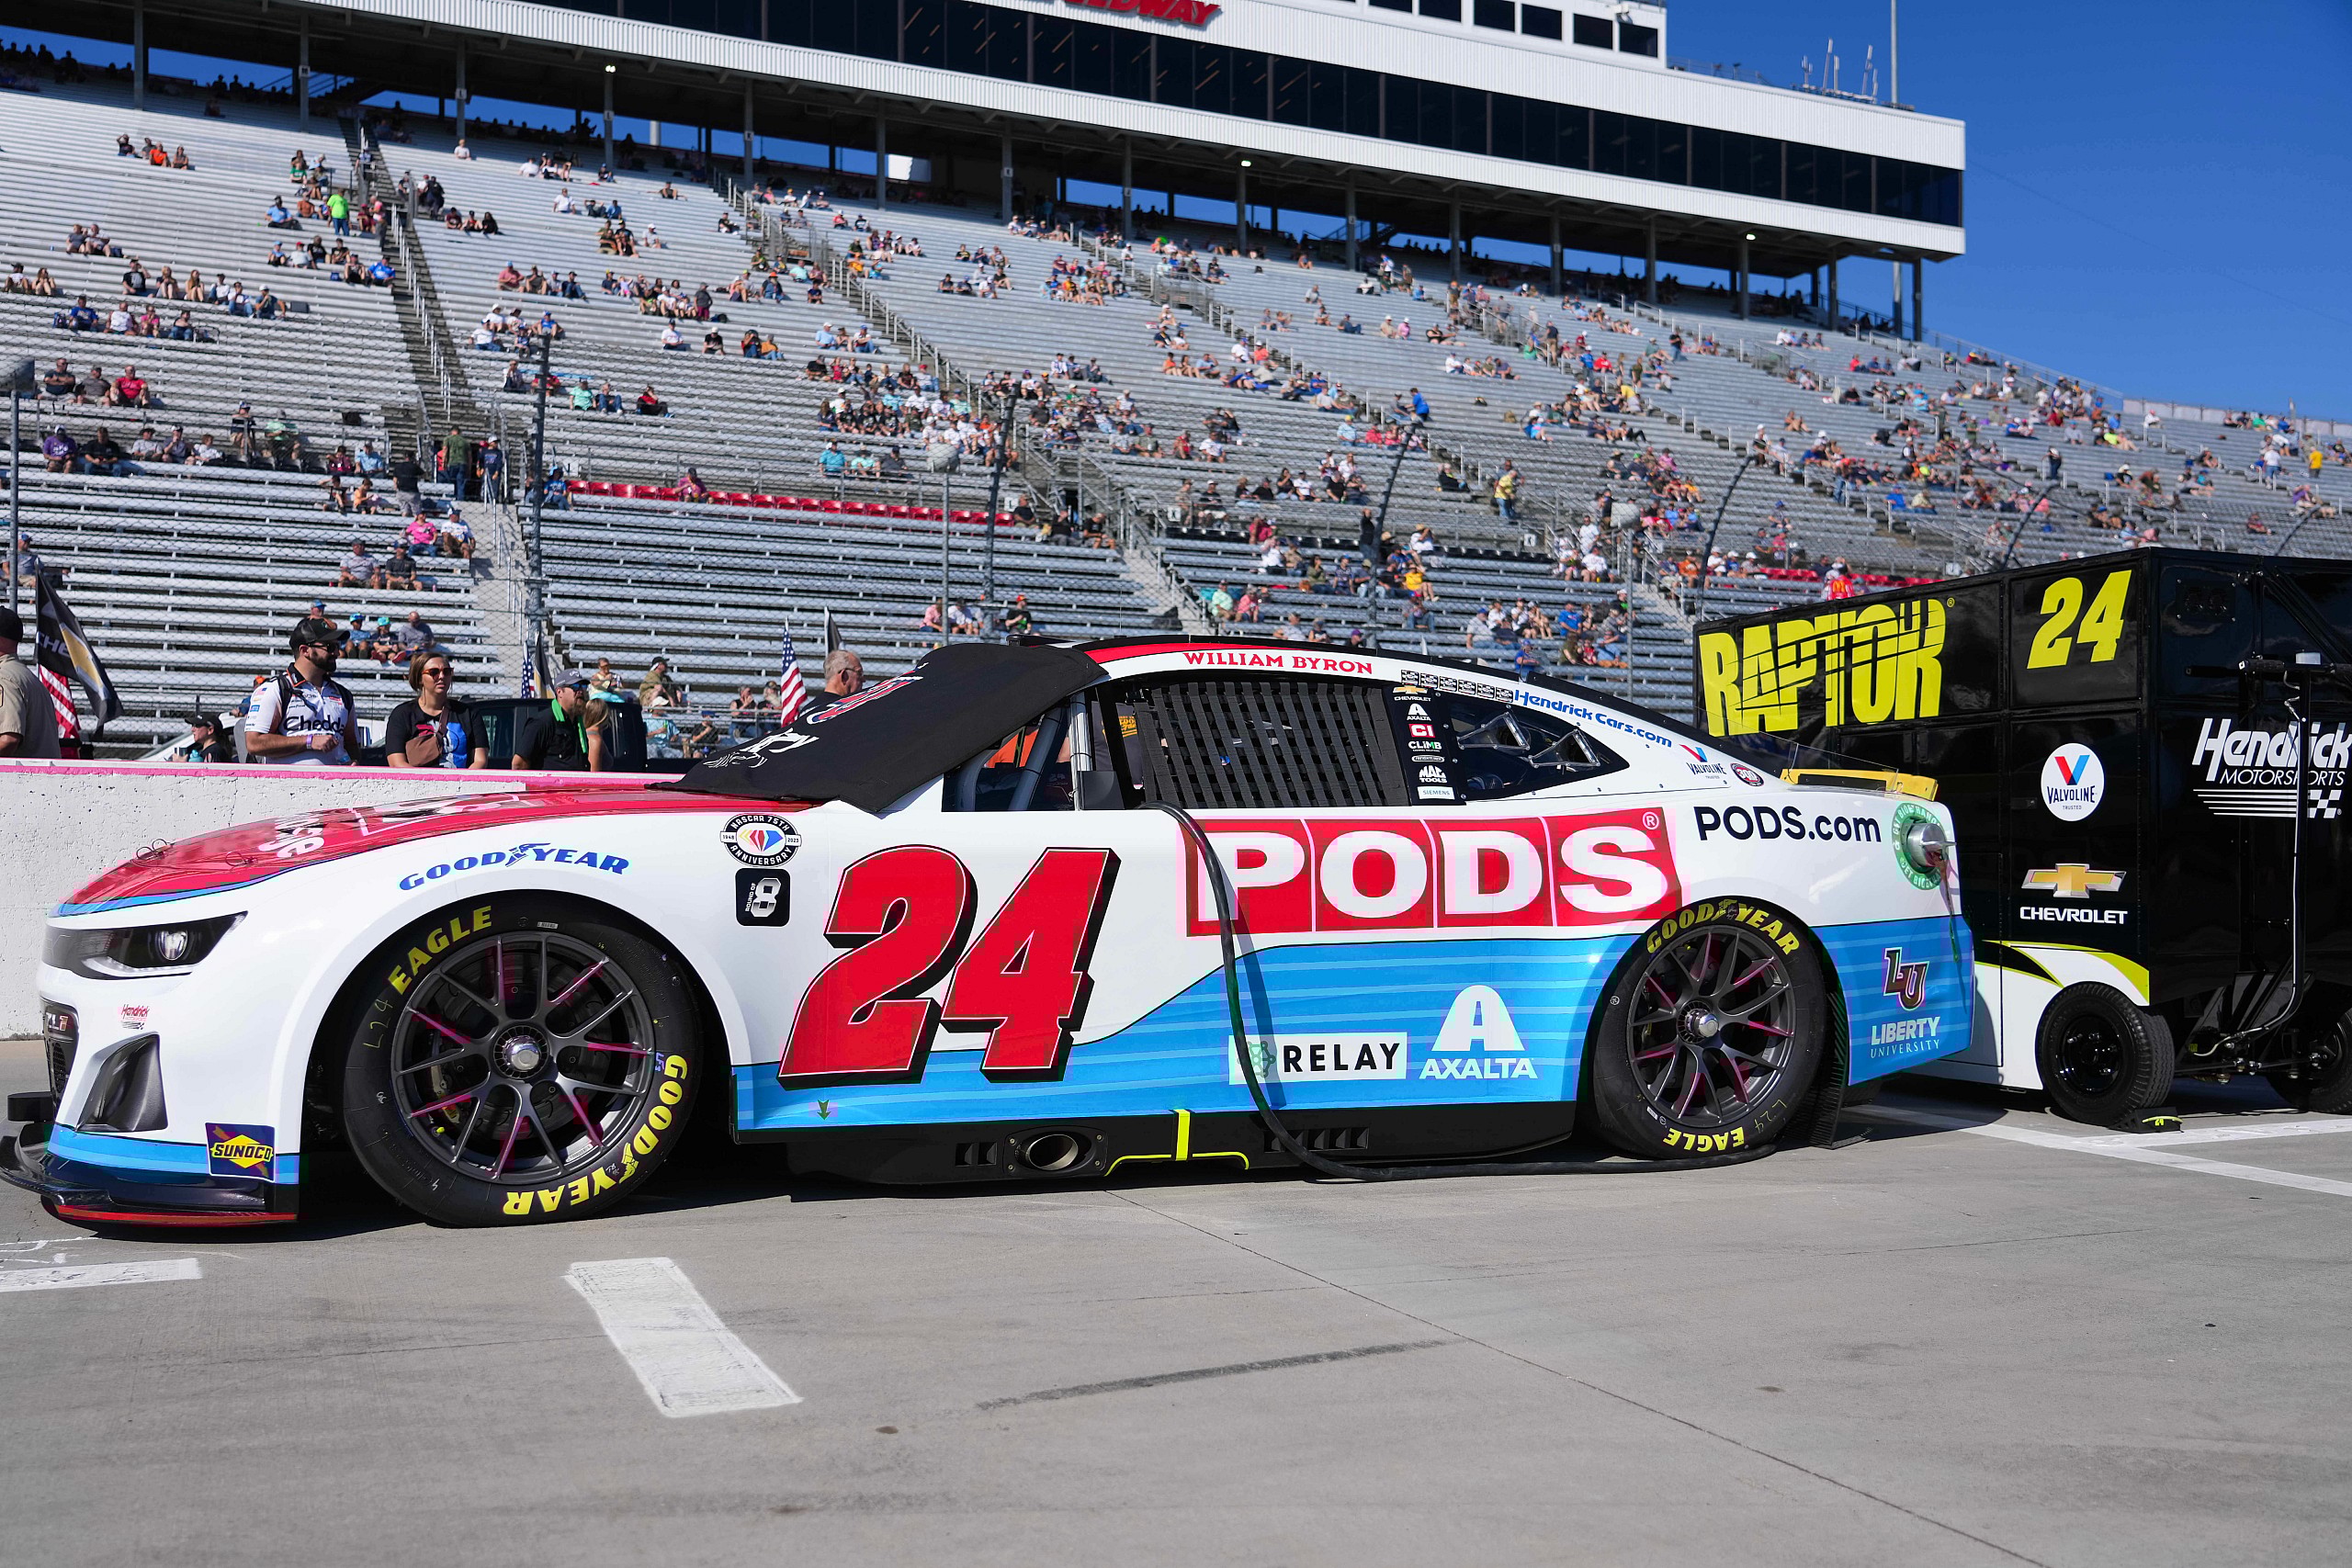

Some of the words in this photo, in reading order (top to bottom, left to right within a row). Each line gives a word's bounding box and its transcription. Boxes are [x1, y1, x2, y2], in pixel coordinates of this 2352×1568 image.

[2026, 570, 2132, 670] 24
[1182, 652, 1283, 668] WILLIAM
[1293, 656, 1373, 675] BYRON
[1699, 599, 1946, 737] RAPTOR
[1410, 724, 1434, 738] CI
[1408, 740, 1442, 750] CLIMB
[1419, 764, 1447, 779] MAC
[1685, 761, 1727, 775] VALVOLINE
[2220, 768, 2346, 786] MOTORSORTS
[2046, 784, 2096, 805] VALVOLINE
[729, 815, 764, 829] NASCAR
[767, 816, 790, 831] 75TH
[1693, 806, 1883, 843] PODS.com
[729, 844, 792, 865] ANNIVERSARY
[1196, 826, 1668, 922] PODS
[745, 891, 754, 912] ROUND
[751, 882, 756, 891] OF
[751, 877, 782, 918] 8
[2019, 906, 2129, 925] CHEVROLET
[388, 905, 492, 996] EAGLE
[776, 844, 1122, 1091] 24
[1883, 946, 1930, 1011] LU
[120, 1003, 151, 1021] Hendrick
[1871, 1016, 1941, 1046] LIBERTY
[1283, 1043, 1400, 1073] RELAY
[1870, 1039, 1940, 1059] UNIVERSITY
[1419, 1057, 1539, 1080] AXALTA
[1662, 1125, 1745, 1152] EAGLE
[213, 1143, 274, 1160] SUNOCO
